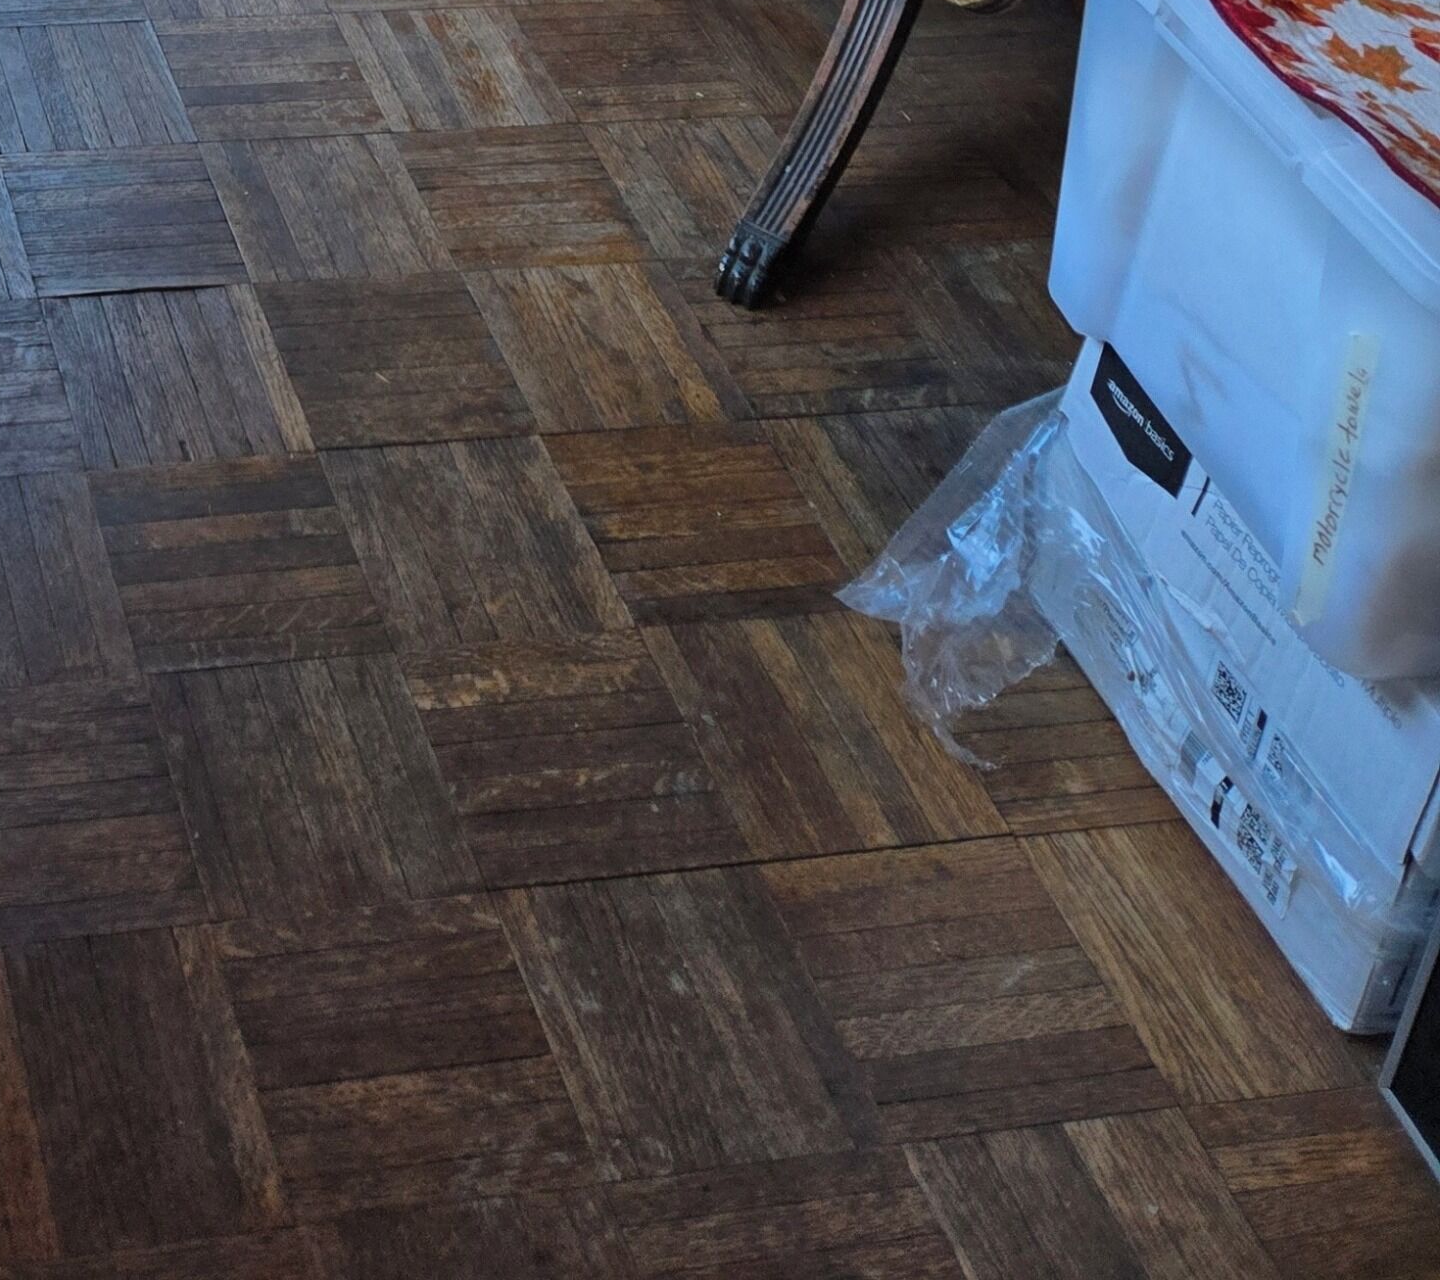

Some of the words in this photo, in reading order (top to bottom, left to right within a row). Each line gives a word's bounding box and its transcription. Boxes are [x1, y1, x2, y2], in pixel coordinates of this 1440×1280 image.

[1106, 378, 1145, 427] amazon
[1143, 420, 1174, 461] basics
[1214, 499, 1243, 537] Papier
[1231, 546, 1248, 571] De
